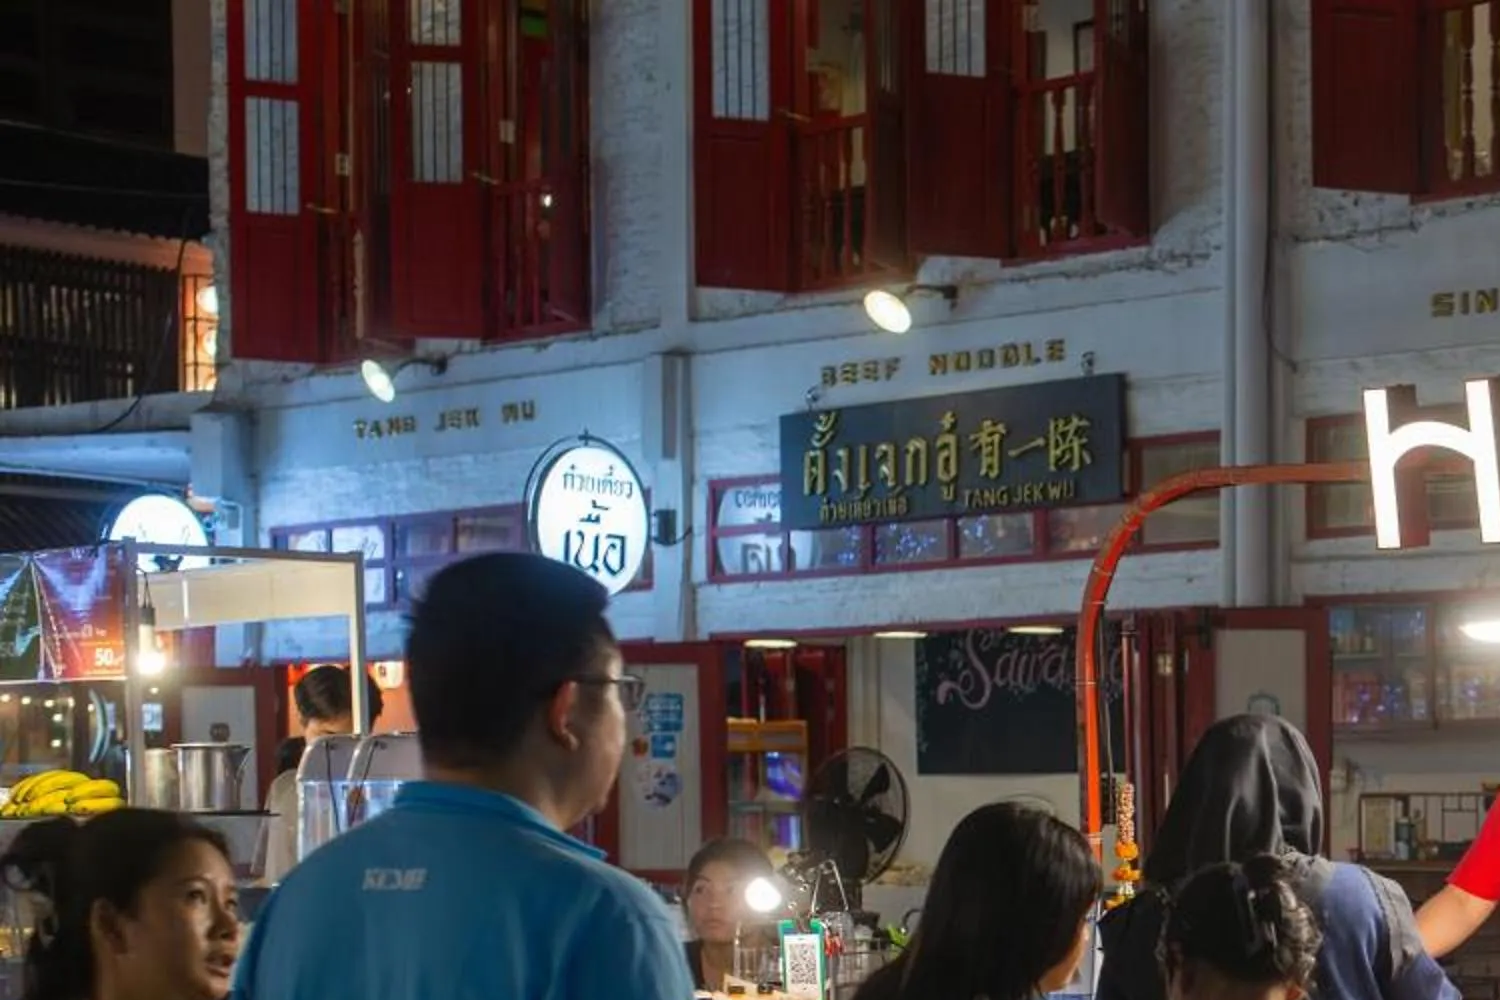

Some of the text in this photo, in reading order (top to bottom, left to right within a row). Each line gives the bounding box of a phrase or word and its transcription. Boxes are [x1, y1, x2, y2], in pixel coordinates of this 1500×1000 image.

[820, 339, 1067, 387] BEEF NOODLE
[964, 485, 1010, 510] TANG
